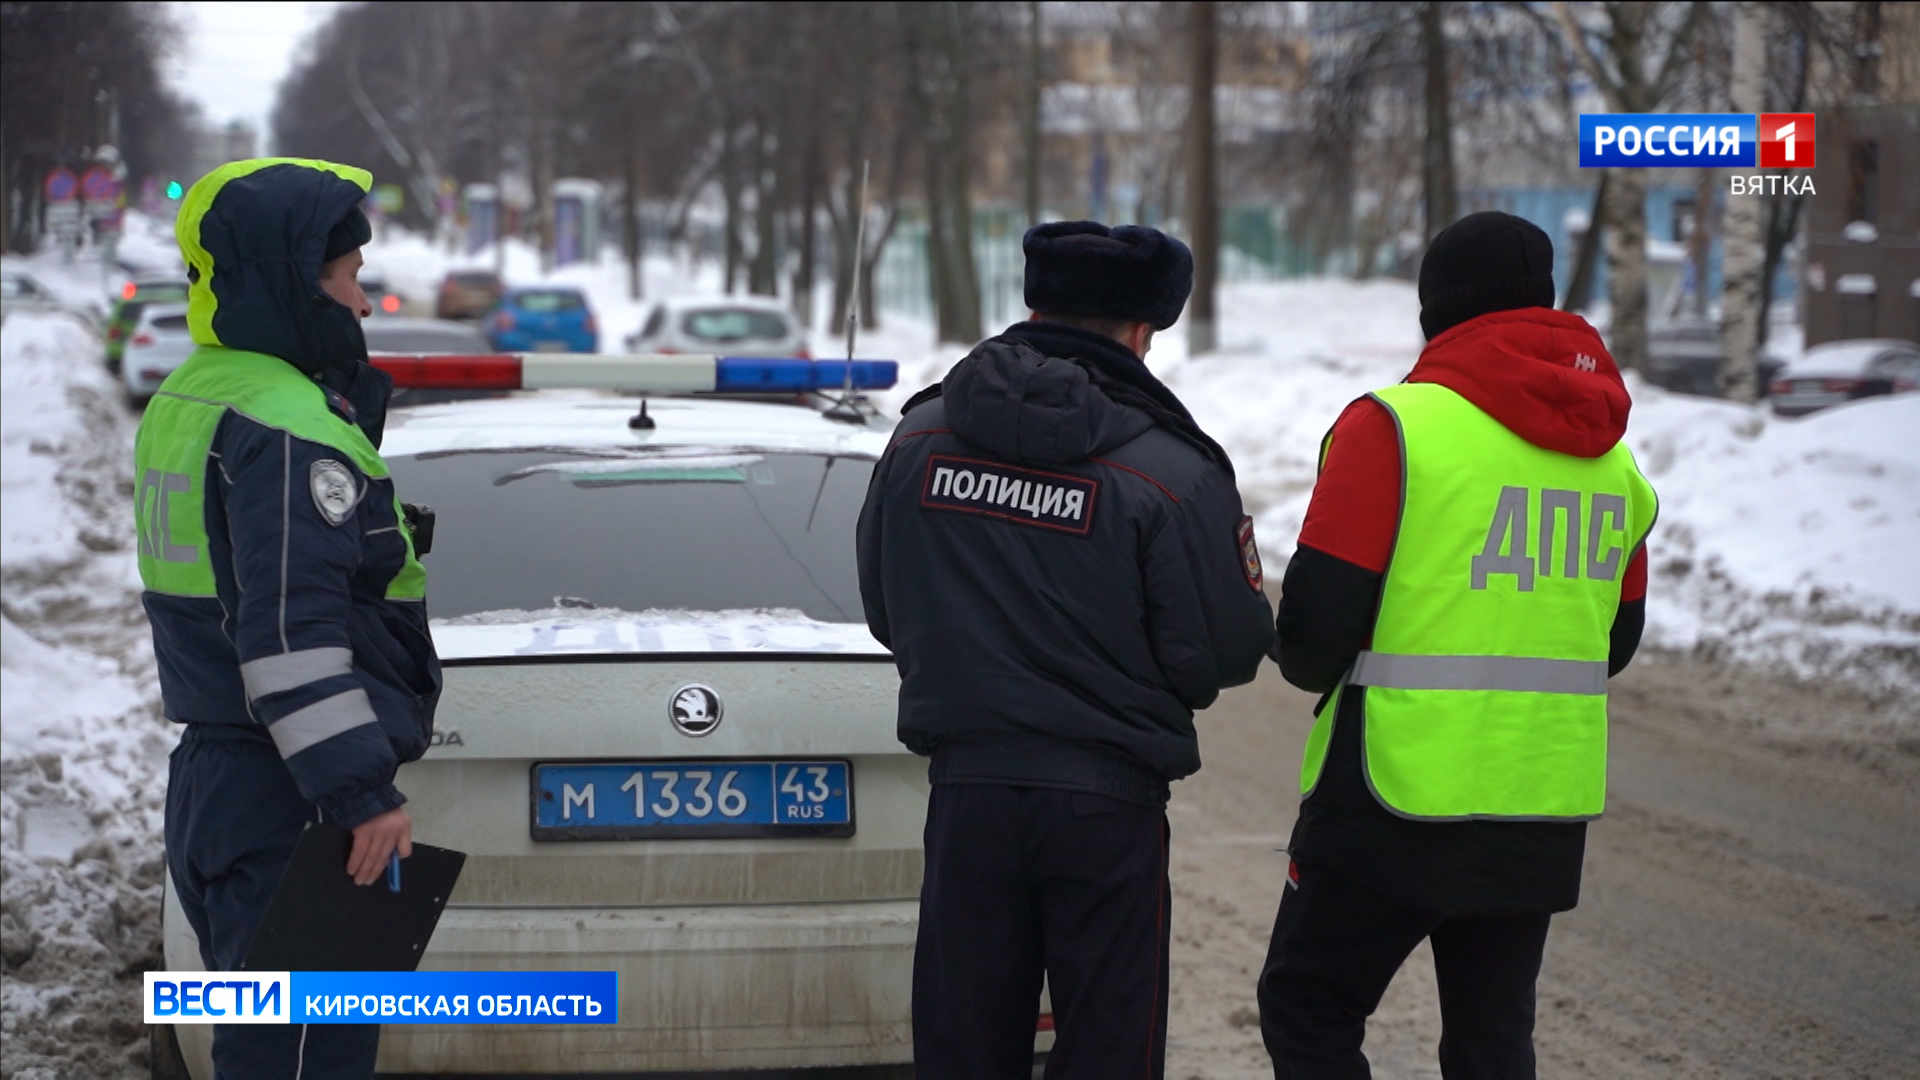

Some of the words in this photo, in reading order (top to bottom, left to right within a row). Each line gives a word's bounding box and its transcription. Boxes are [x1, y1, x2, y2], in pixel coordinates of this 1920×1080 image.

[140, 467, 199, 564] ПС
[931, 466, 1086, 521] ПОЛИЦИЯ
[1470, 485, 1627, 592] ДПС
[620, 771, 748, 819] 1336
[780, 767, 830, 803] 43
[787, 805, 825, 819] RUS
